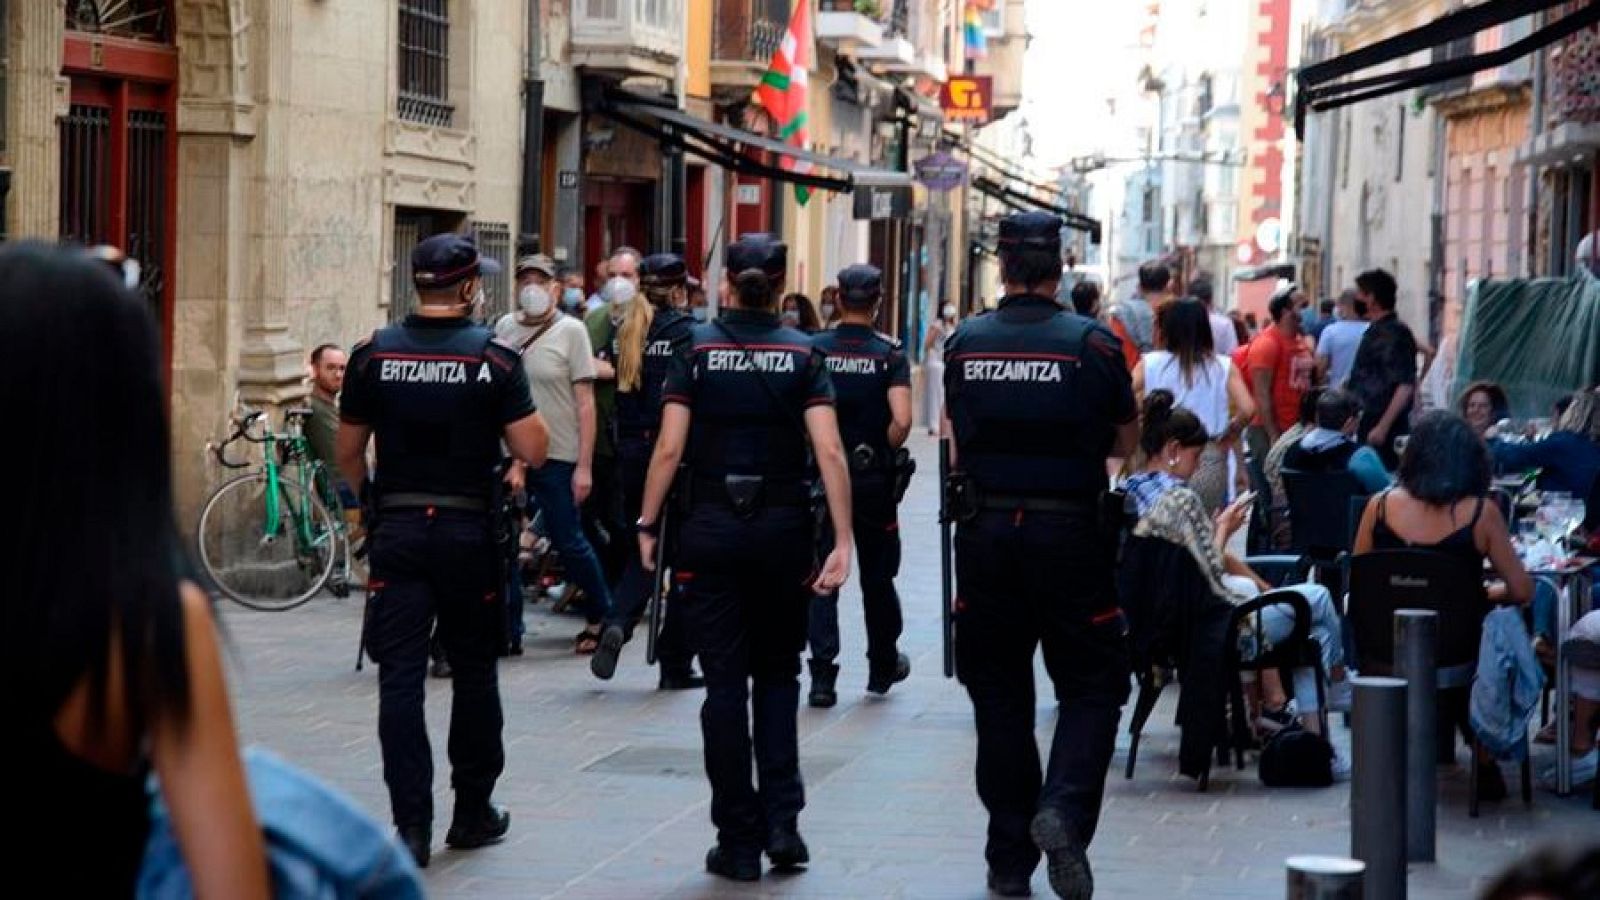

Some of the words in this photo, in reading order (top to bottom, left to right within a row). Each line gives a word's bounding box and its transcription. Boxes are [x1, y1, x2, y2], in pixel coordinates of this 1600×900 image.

[381, 359, 467, 383] ERTZAINTZA
[708, 350, 794, 373] ERTZAINTZA
[964, 360, 1062, 382] ERTZAINTZA
